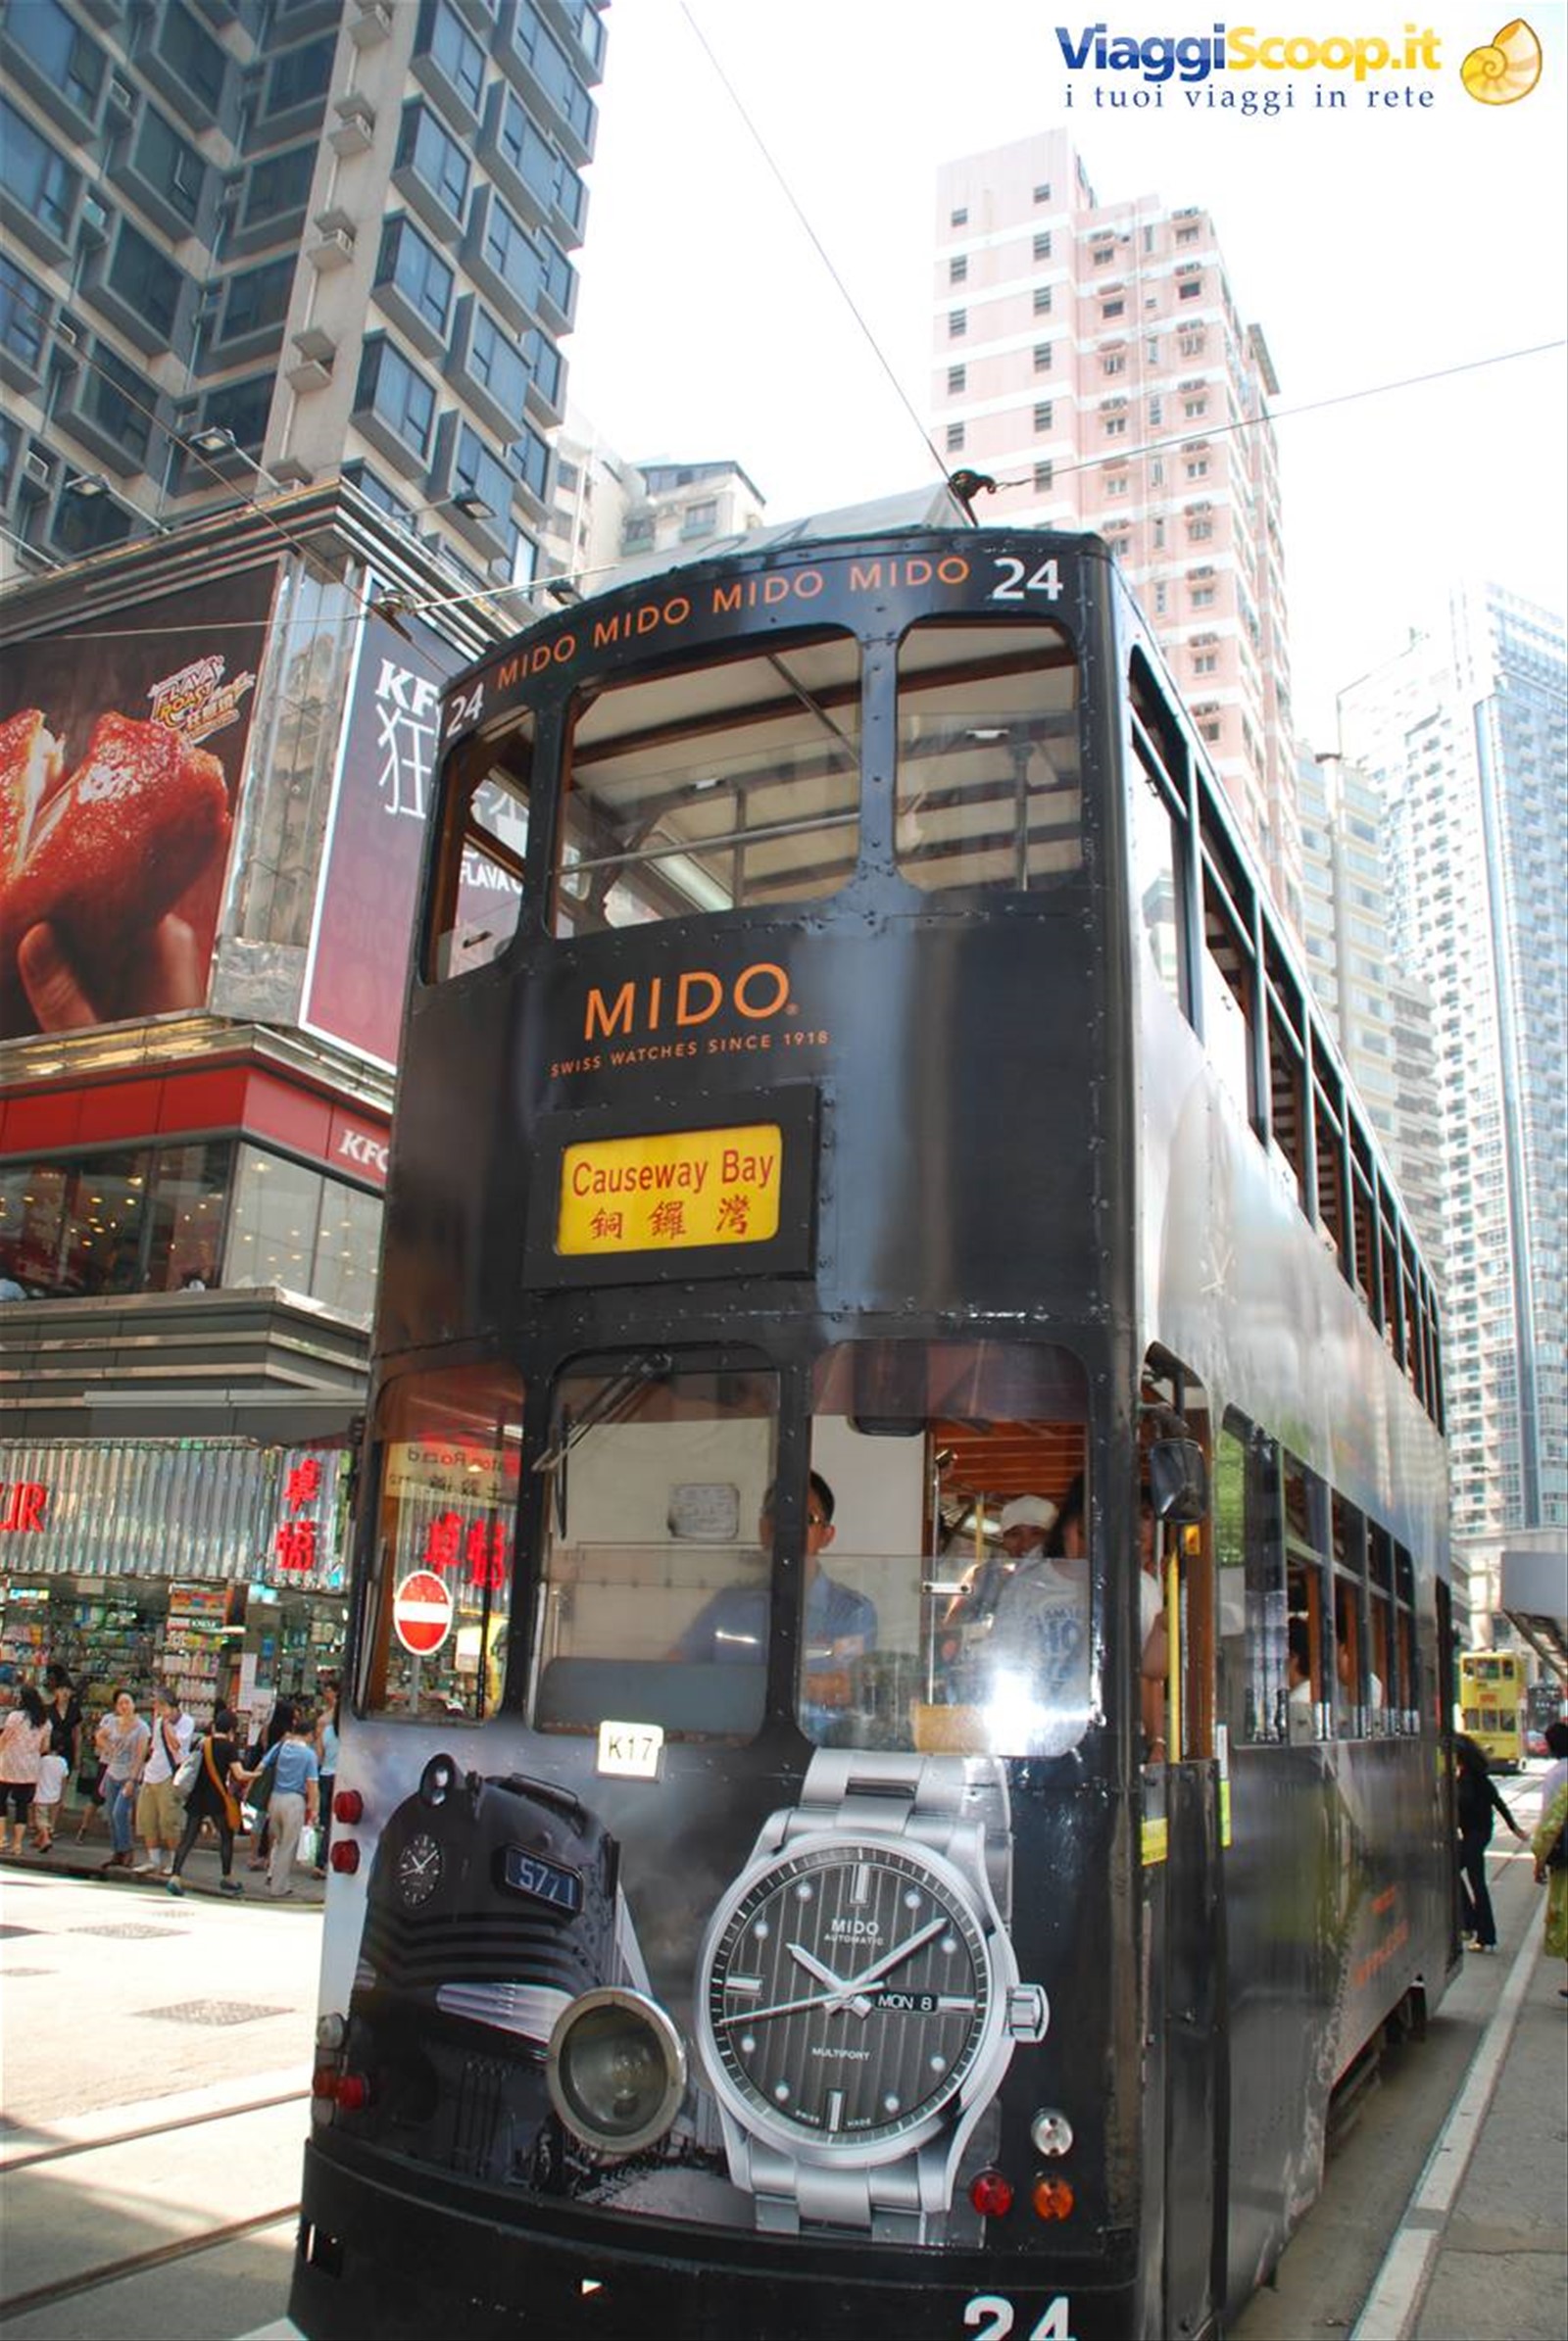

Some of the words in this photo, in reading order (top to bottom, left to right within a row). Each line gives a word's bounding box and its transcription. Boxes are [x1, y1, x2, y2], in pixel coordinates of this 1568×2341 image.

[446, 682, 484, 738] 24
[498, 634, 576, 689] MIDO
[593, 596, 690, 649] MIDO
[712, 570, 824, 614] MIDO
[850, 556, 970, 589] MIDO
[992, 558, 1063, 601] 24
[375, 658, 441, 718] KF
[584, 962, 790, 1041] MIDO
[550, 1057, 602, 1078] SWISS
[611, 1041, 698, 1066] WATCHES
[709, 1035, 772, 1053] SINCE
[783, 1030, 830, 1047] 1918
[572, 1160, 709, 1197] Causeway
[721, 1149, 774, 1189] Bay
[589, 1195, 752, 1240] 銅鑼灣
[608, 1737, 655, 1761] K17
[831, 1918, 879, 1935] MIDO
[878, 1994, 913, 2010] MON
[921, 1996, 932, 2011] 8
